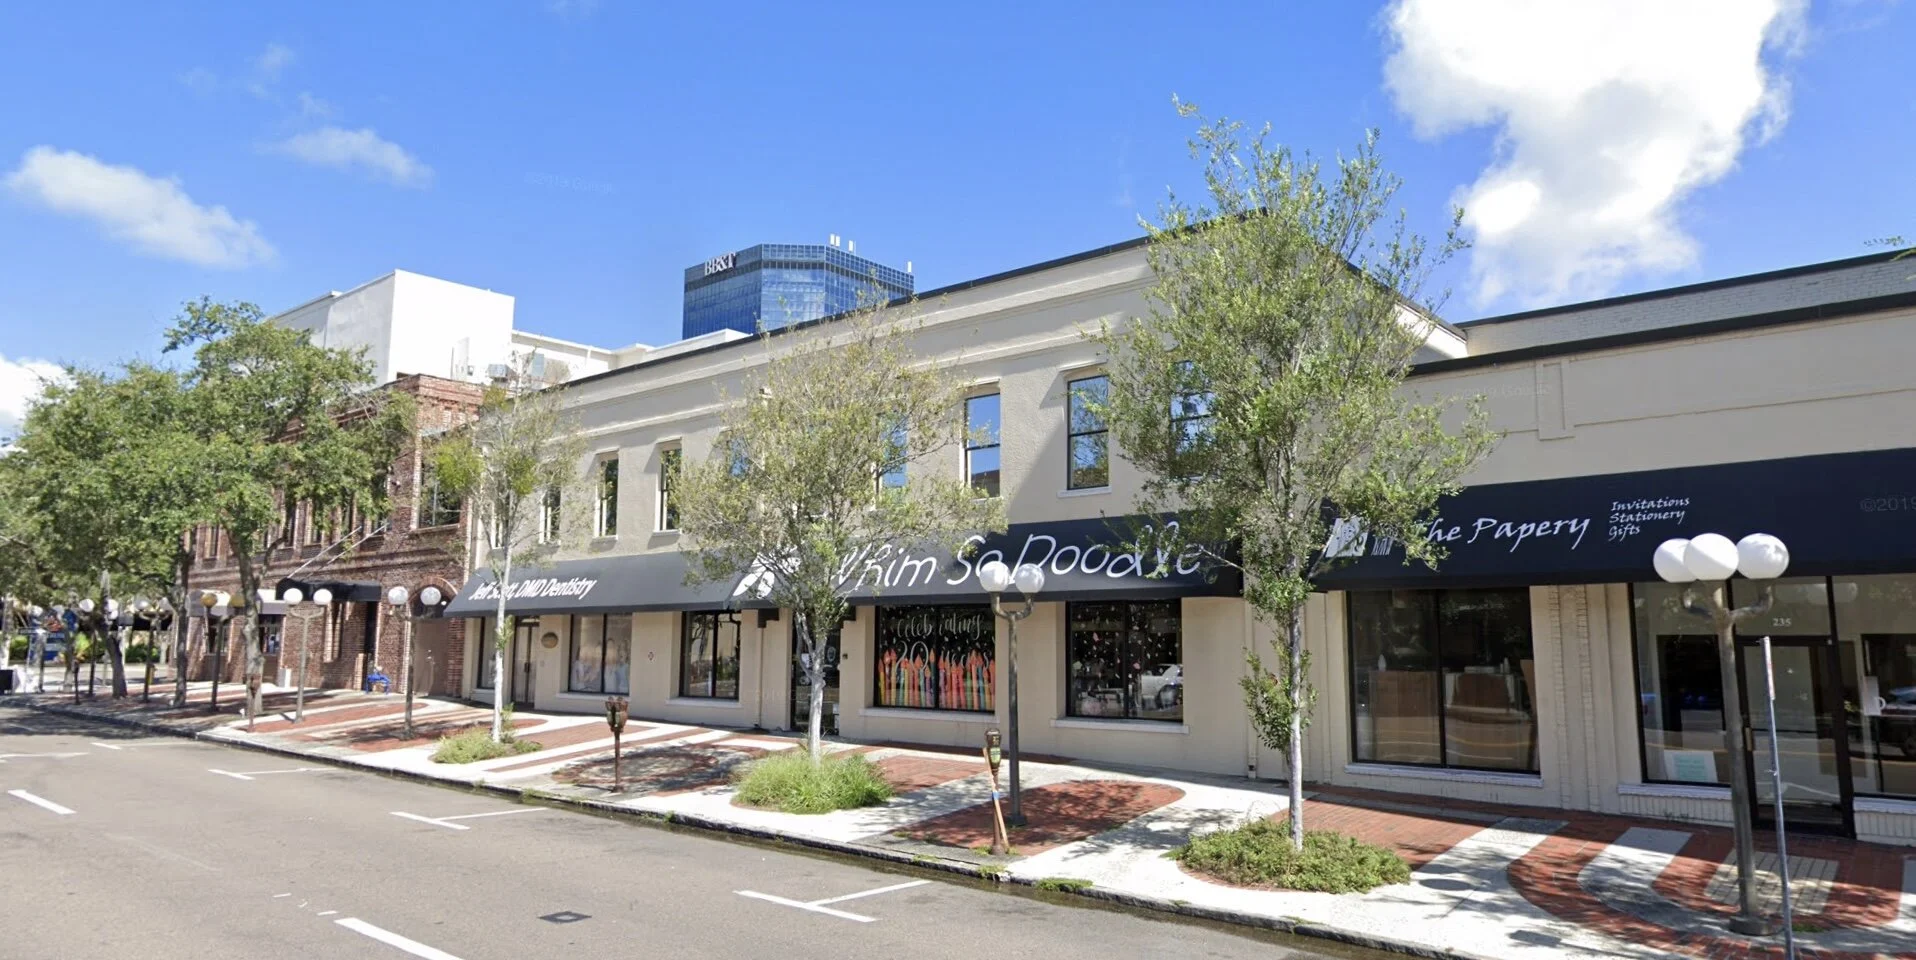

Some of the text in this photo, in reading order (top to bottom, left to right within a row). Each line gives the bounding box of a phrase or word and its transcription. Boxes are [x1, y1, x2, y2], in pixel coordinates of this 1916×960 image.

[704, 252, 736, 276] BB&T
[1610, 496, 1690, 511] Invitations
[1609, 509, 1685, 525] Stationery
[1467, 517, 1592, 553] Papery
[1607, 523, 1640, 542] Gifts
[1008, 520, 1202, 585] Doodle
[468, 576, 598, 601] Jeff Sctt, DMD Dentistry
[1772, 617, 1792, 627] 235
[895, 640, 929, 674] 20
